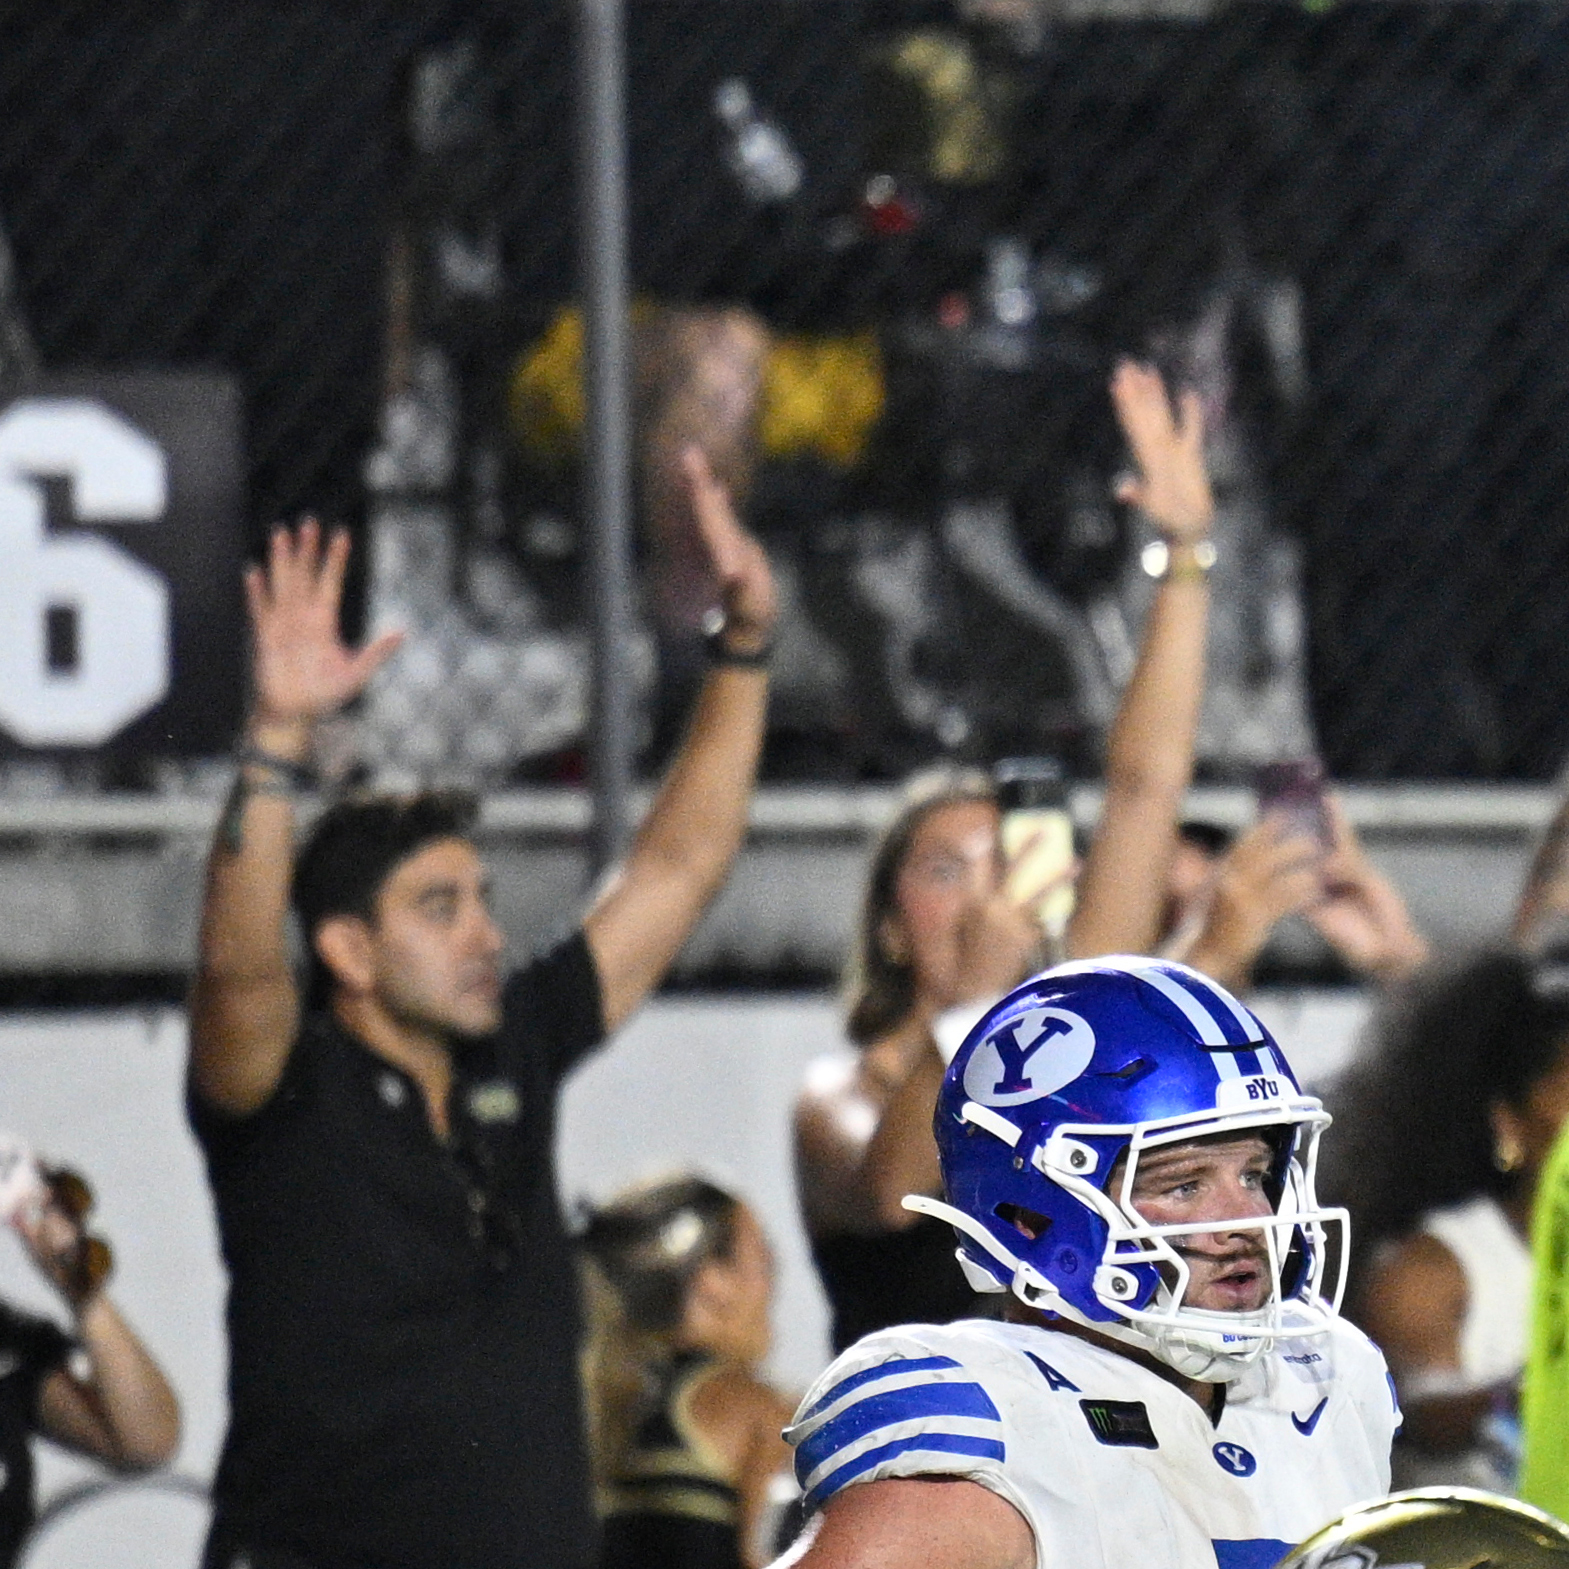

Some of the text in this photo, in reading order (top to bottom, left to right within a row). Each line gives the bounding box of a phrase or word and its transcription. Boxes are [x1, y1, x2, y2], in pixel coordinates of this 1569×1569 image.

[985, 1016, 1073, 1095] Y
[1245, 1077, 1279, 1100] BYU
[1023, 1350, 1082, 1392] A
[1217, 1446, 1247, 1471] Y
